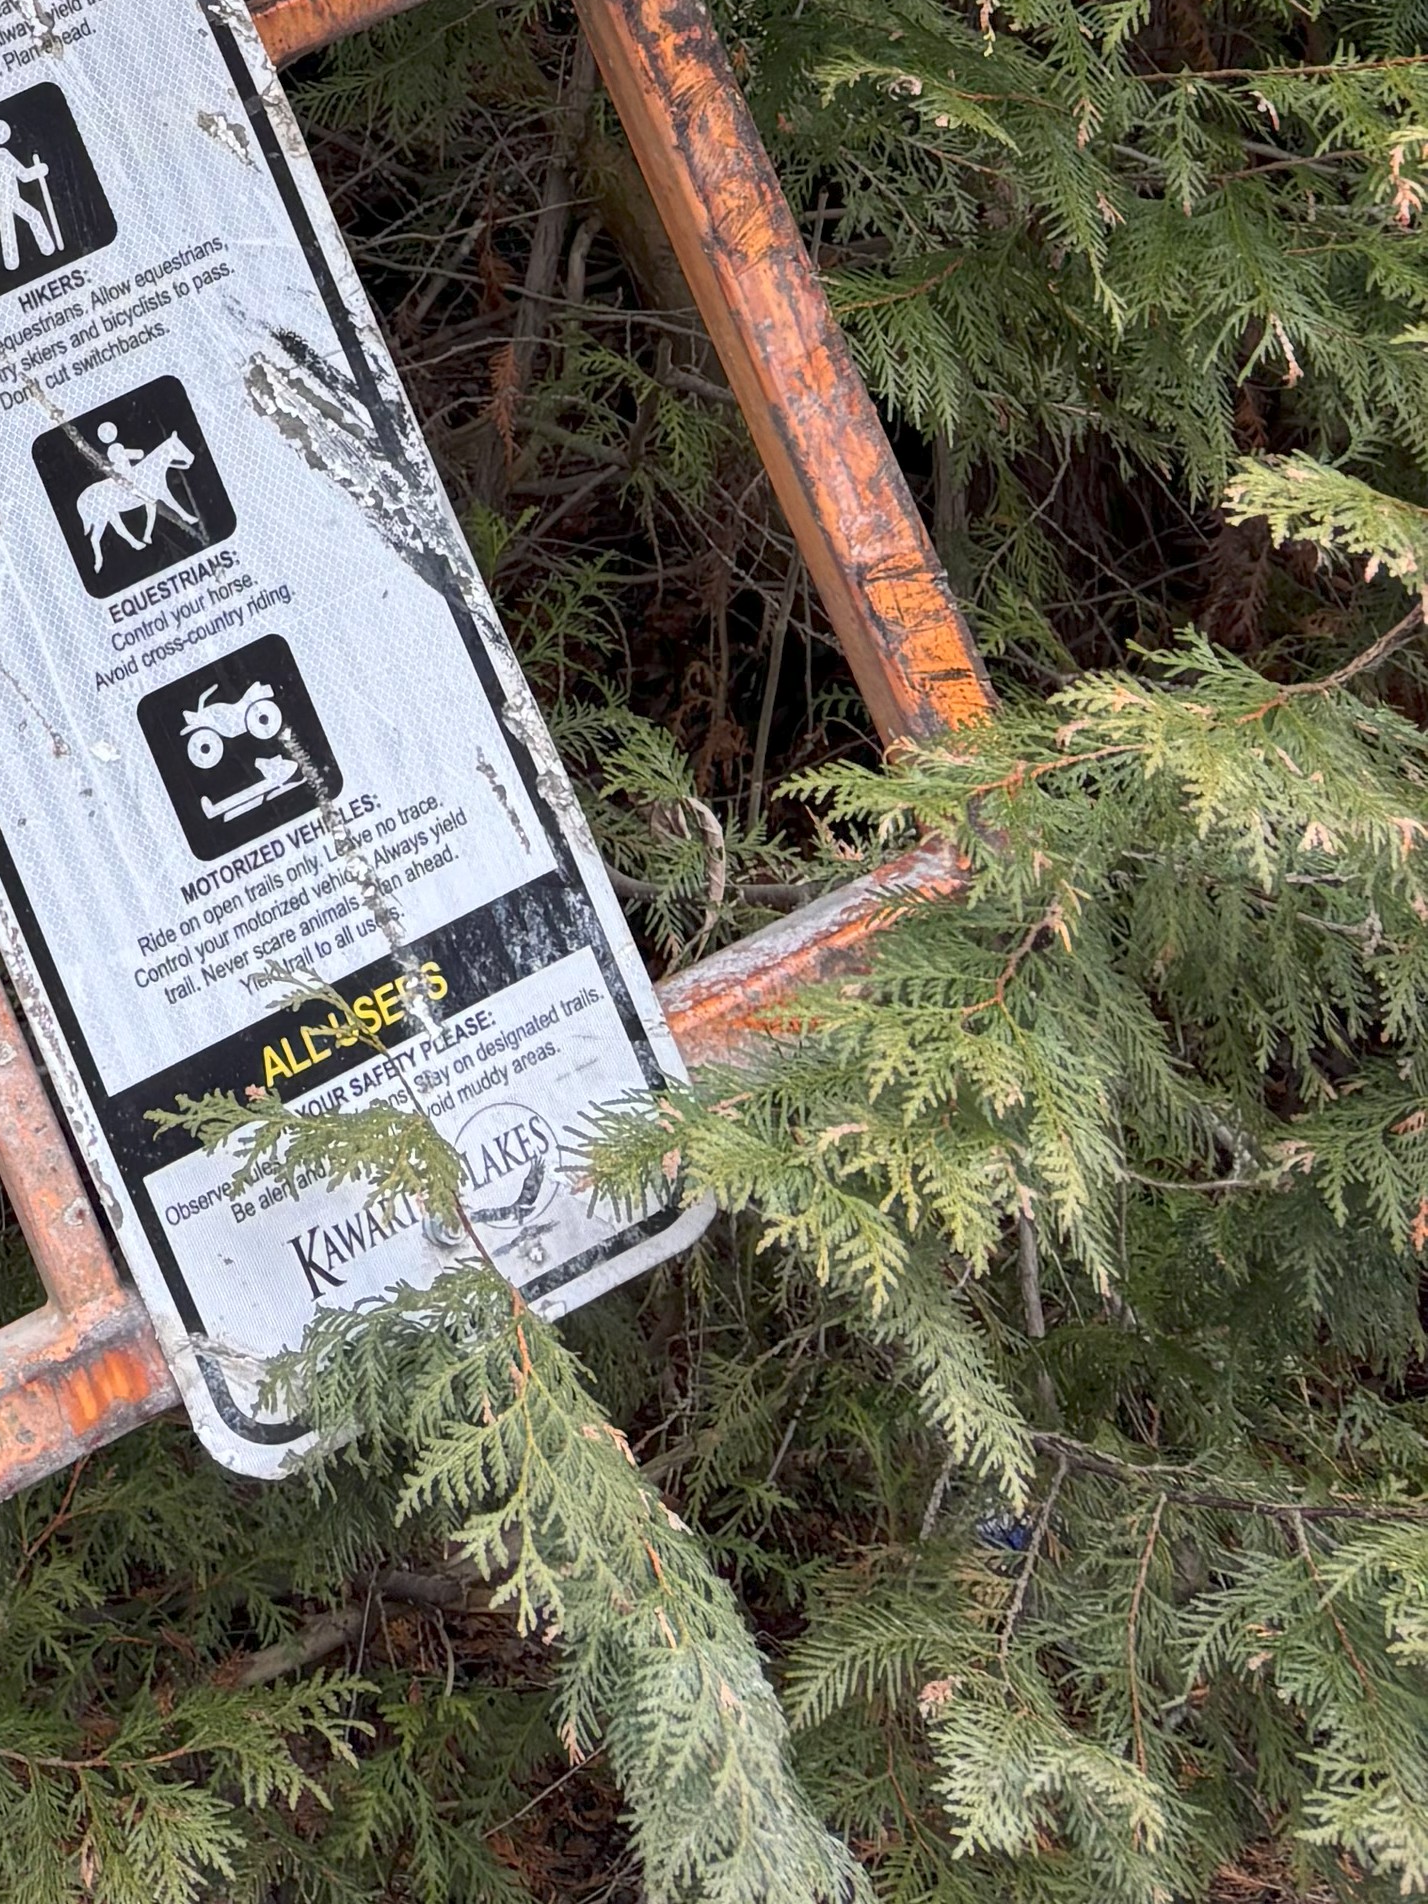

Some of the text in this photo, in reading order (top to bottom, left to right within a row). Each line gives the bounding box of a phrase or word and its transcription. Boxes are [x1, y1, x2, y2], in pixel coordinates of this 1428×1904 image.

[1, 43, 41, 72] Plan
[17, 268, 91, 314] HIKERS:
[90, 278, 131, 311] Allow
[133, 236, 229, 288] equestrians,
[19, 339, 68, 372] skiers
[68, 319, 100, 348] and
[99, 289, 172, 333] bicyclists
[171, 281, 190, 298] to
[191, 261, 235, 294] pass.
[44, 362, 71, 389] cut
[71, 321, 170, 376] switchbacks.
[107, 549, 241, 624] EQUESTRIANS:
[110, 573, 258, 652] Control your horse.
[94, 583, 296, 692] Avoid cross-country riding.
[133, 945, 194, 988] Control
[193, 929, 230, 965] your
[232, 886, 311, 940] motorized
[373, 830, 429, 869] Always
[428, 805, 468, 844] yield
[136, 927, 177, 957] Ride
[178, 915, 201, 936] on
[202, 894, 244, 925] open
[243, 872, 284, 903] trails
[285, 854, 324, 883] only.
[374, 816, 396, 838] no
[396, 795, 443, 825] trace.
[179, 838, 285, 905] MOTORIZED
[163, 974, 201, 1005] trail.
[200, 950, 249, 987] Never
[252, 927, 297, 960] scare
[403, 842, 459, 883] ahead.
[281, 943, 315, 975] trail
[313, 940, 332, 959] to
[333, 924, 355, 949] all
[262, 1026, 332, 1088] ALL
[295, 1086, 345, 1120] YOUR
[352, 1048, 417, 1098] SAFETY
[421, 1010, 498, 1062] PLEASE:
[164, 1180, 231, 1227] Observe
[411, 1060, 454, 1096] Stay
[452, 1053, 475, 1074] on
[475, 1003, 560, 1062] designated
[559, 986, 604, 1017] trails.
[229, 1201, 256, 1224] Be
[456, 1064, 509, 1104] muddy
[511, 1040, 561, 1074] areas.
[470, 1114, 549, 1192] LAKES
